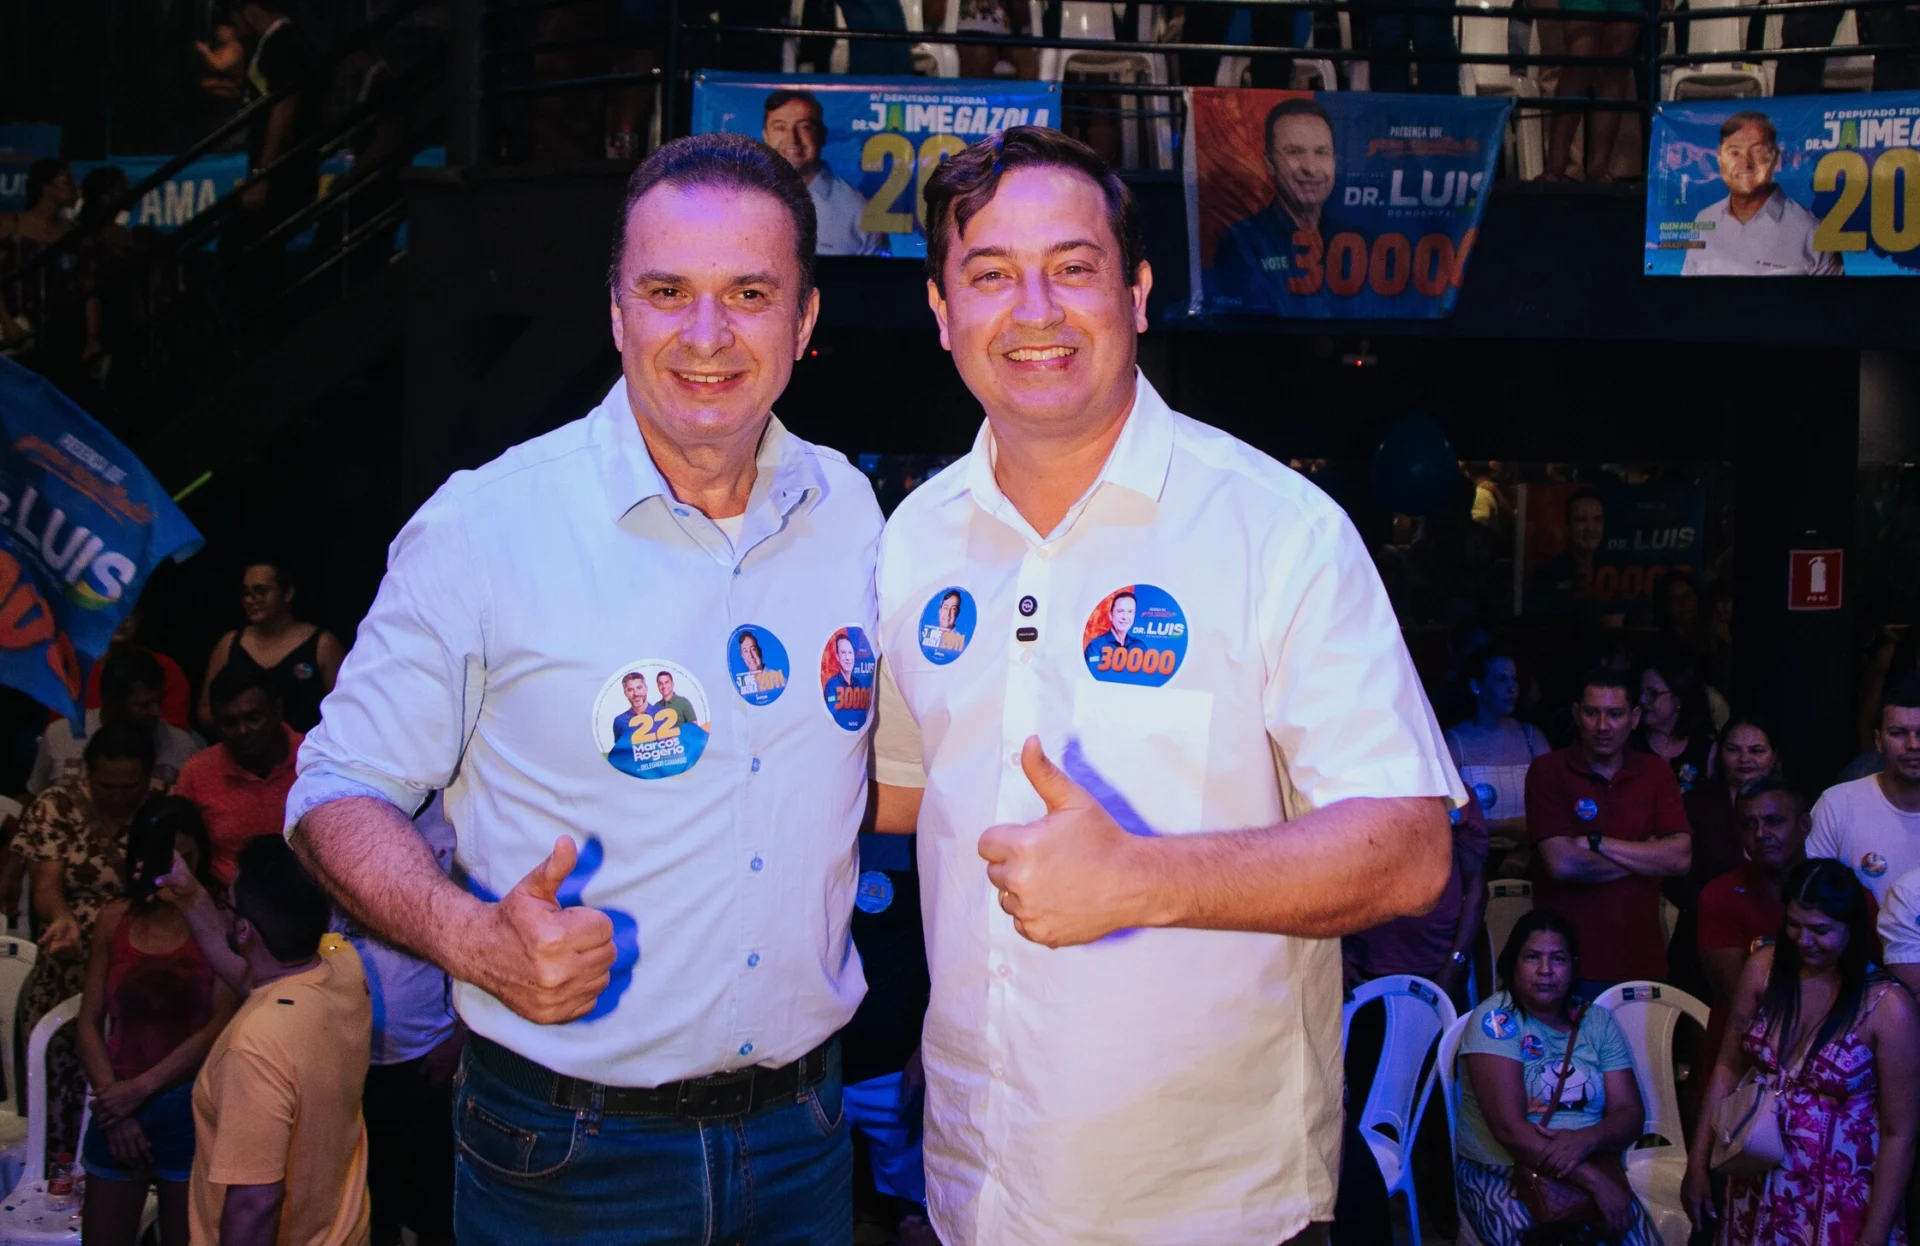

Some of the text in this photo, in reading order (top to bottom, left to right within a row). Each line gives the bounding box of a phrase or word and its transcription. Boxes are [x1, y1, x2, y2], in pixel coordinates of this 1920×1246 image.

[883, 93, 940, 104] DEPUTADO
[942, 95, 988, 105] FEDERAL
[1837, 108, 1897, 119] DEPUTADO
[1343, 186, 1385, 206] DR.
[1260, 255, 1290, 272] VOTE
[14, 485, 137, 601] LUIS
[1633, 526, 1696, 551] LUIS
[1132, 621, 1185, 636] DR. LUIS
[1097, 646, 1176, 676] 30000
[628, 707, 681, 746] 22
[632, 737, 680, 754] Marcos
